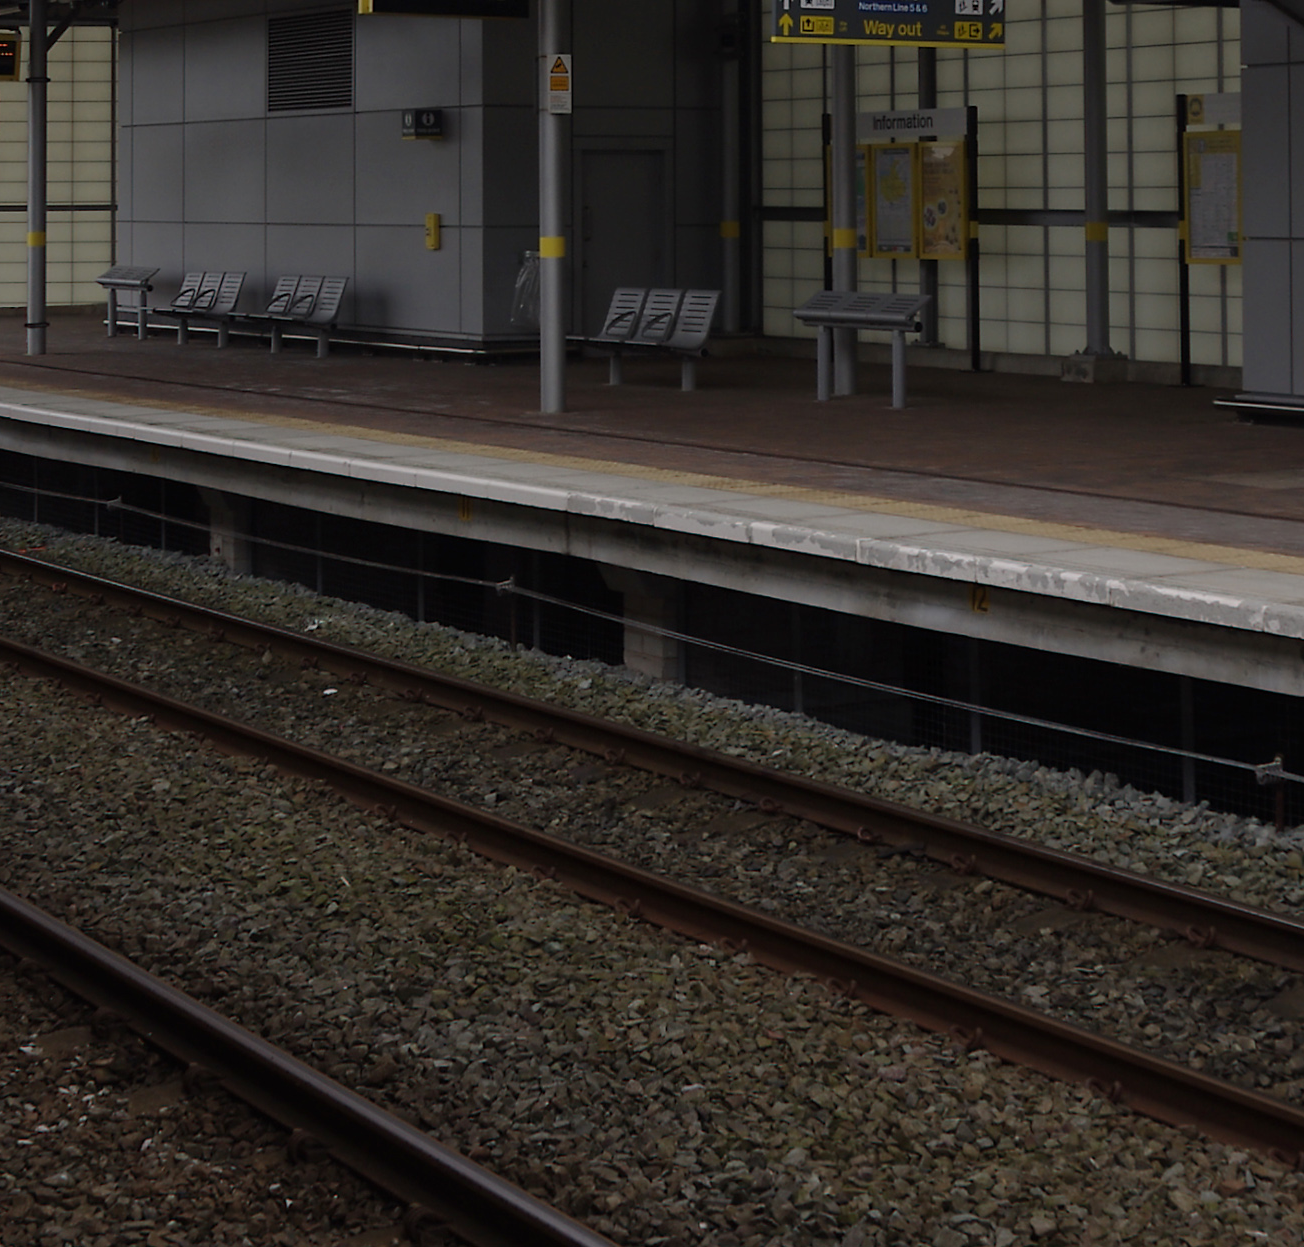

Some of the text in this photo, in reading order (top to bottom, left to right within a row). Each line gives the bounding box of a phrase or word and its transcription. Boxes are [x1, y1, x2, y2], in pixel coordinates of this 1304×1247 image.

[858, 1, 892, 12] Northern
[893, 2, 909, 12] Line
[909, 3, 915, 12] 5
[916, 3, 922, 12] &
[863, 19, 895, 38] Way
[897, 21, 922, 37] out
[873, 113, 934, 131] Information
